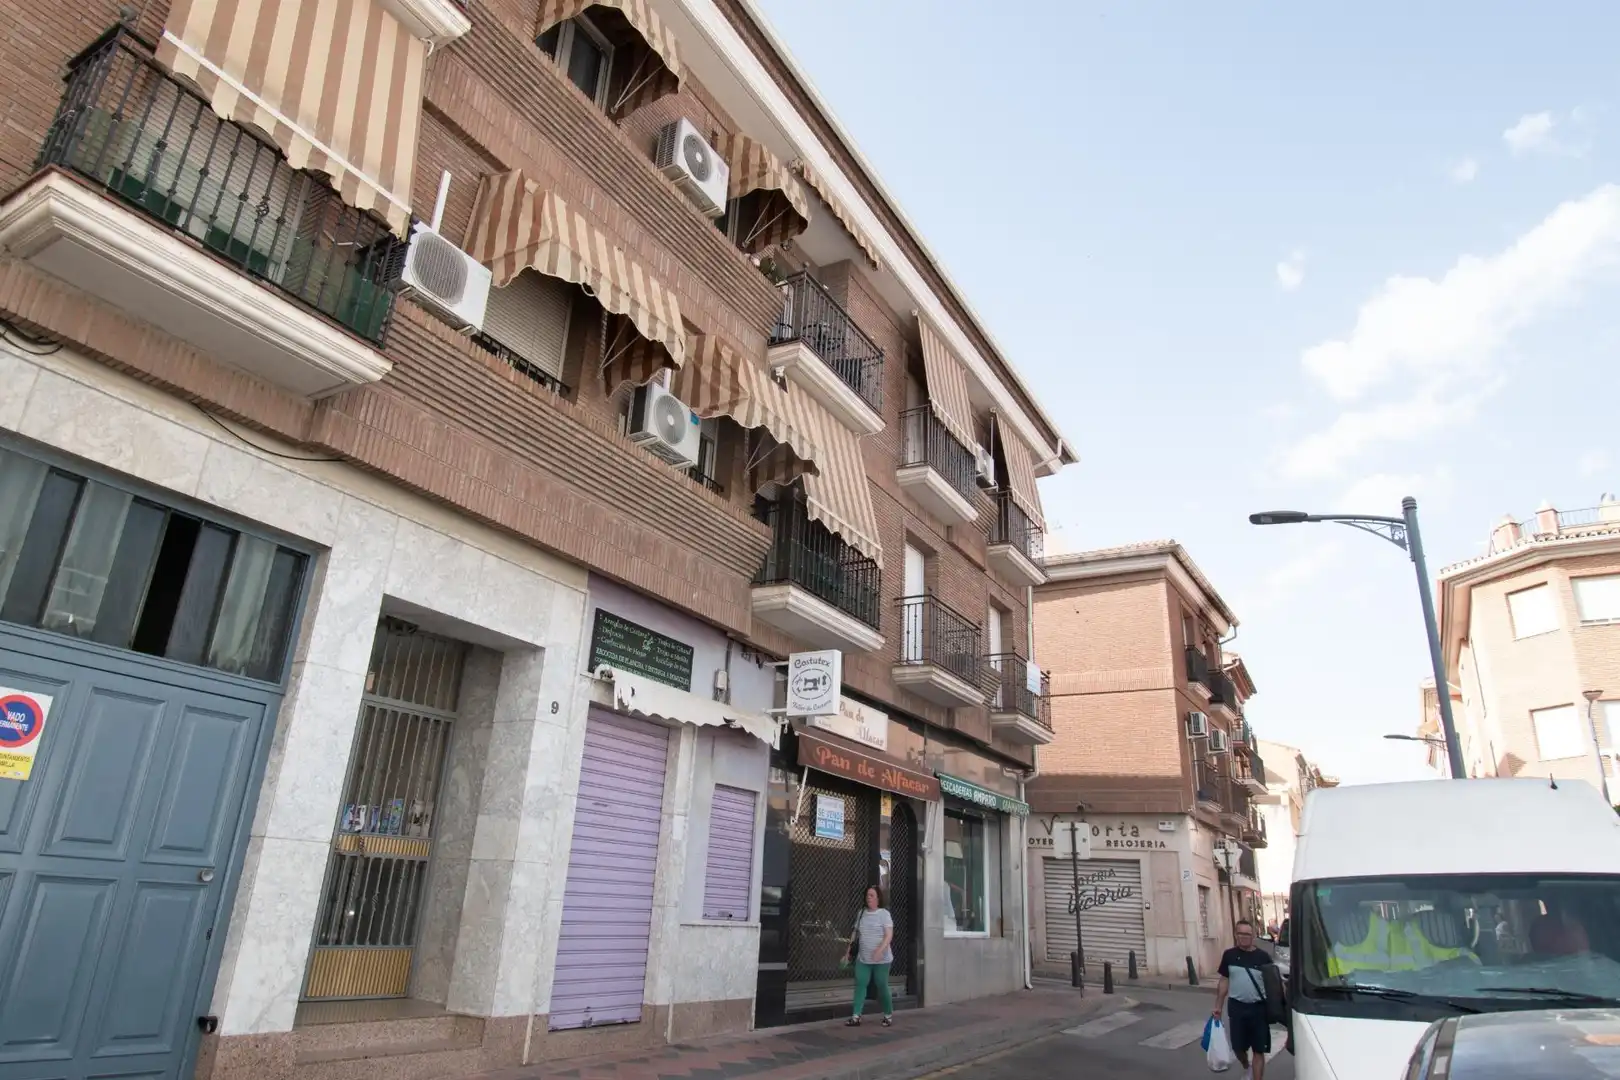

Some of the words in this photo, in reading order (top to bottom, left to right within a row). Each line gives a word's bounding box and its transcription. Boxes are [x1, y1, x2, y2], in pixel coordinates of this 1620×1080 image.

[551, 701, 559, 714] 9
[7, 711, 26, 722] VADO
[0, 720, 29, 732] ERMANENTE
[816, 745, 851, 770] Pan
[857, 759, 876, 778] de
[882, 768, 930, 794] Alfacar
[973, 790, 997, 807] AMPARO
[1106, 839, 1166, 849] RELOJERIA
